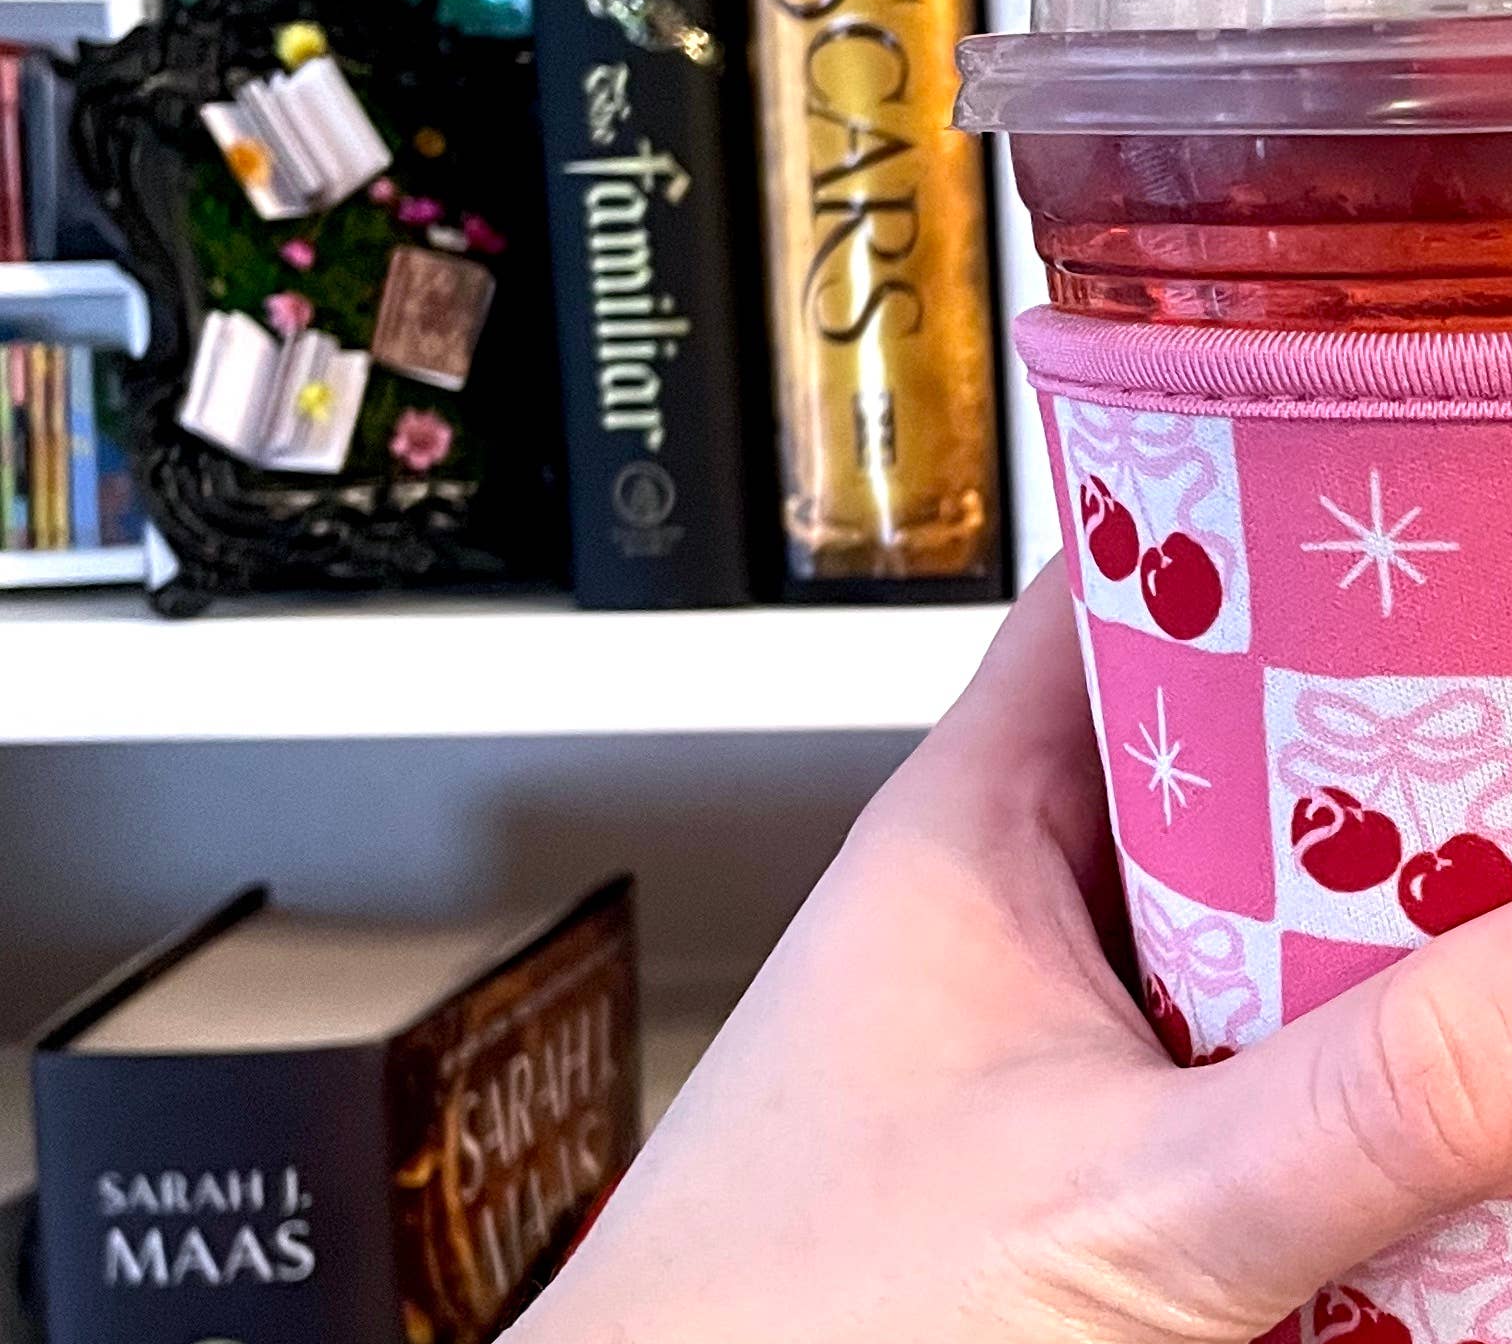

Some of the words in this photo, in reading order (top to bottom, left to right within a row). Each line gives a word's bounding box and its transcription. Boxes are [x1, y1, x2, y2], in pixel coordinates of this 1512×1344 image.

[563, 138, 691, 453] familiar
[97, 1168, 264, 1218] SARAH
[104, 1218, 316, 1290] MAAS
